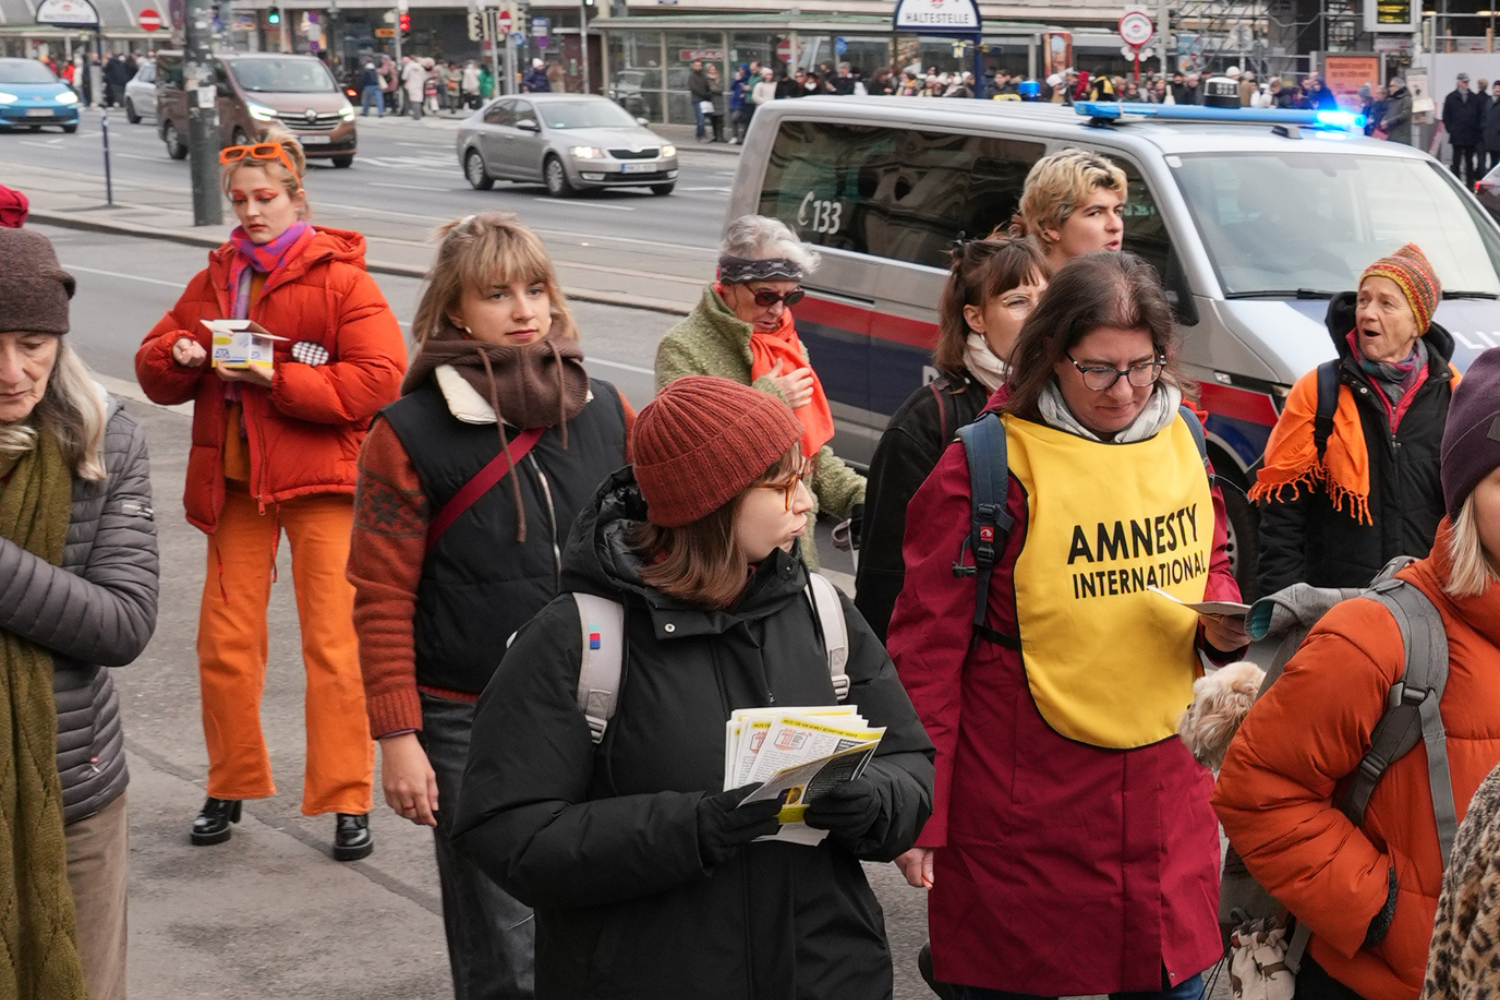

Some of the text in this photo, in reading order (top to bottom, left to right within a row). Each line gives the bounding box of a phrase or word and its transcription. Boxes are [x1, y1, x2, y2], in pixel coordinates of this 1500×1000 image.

[905, 13, 969, 24] HALTESTELLE
[812, 200, 842, 235] 133
[1067, 503, 1198, 565] AMNESTY
[1073, 549, 1206, 599] INTERNATIONAL
